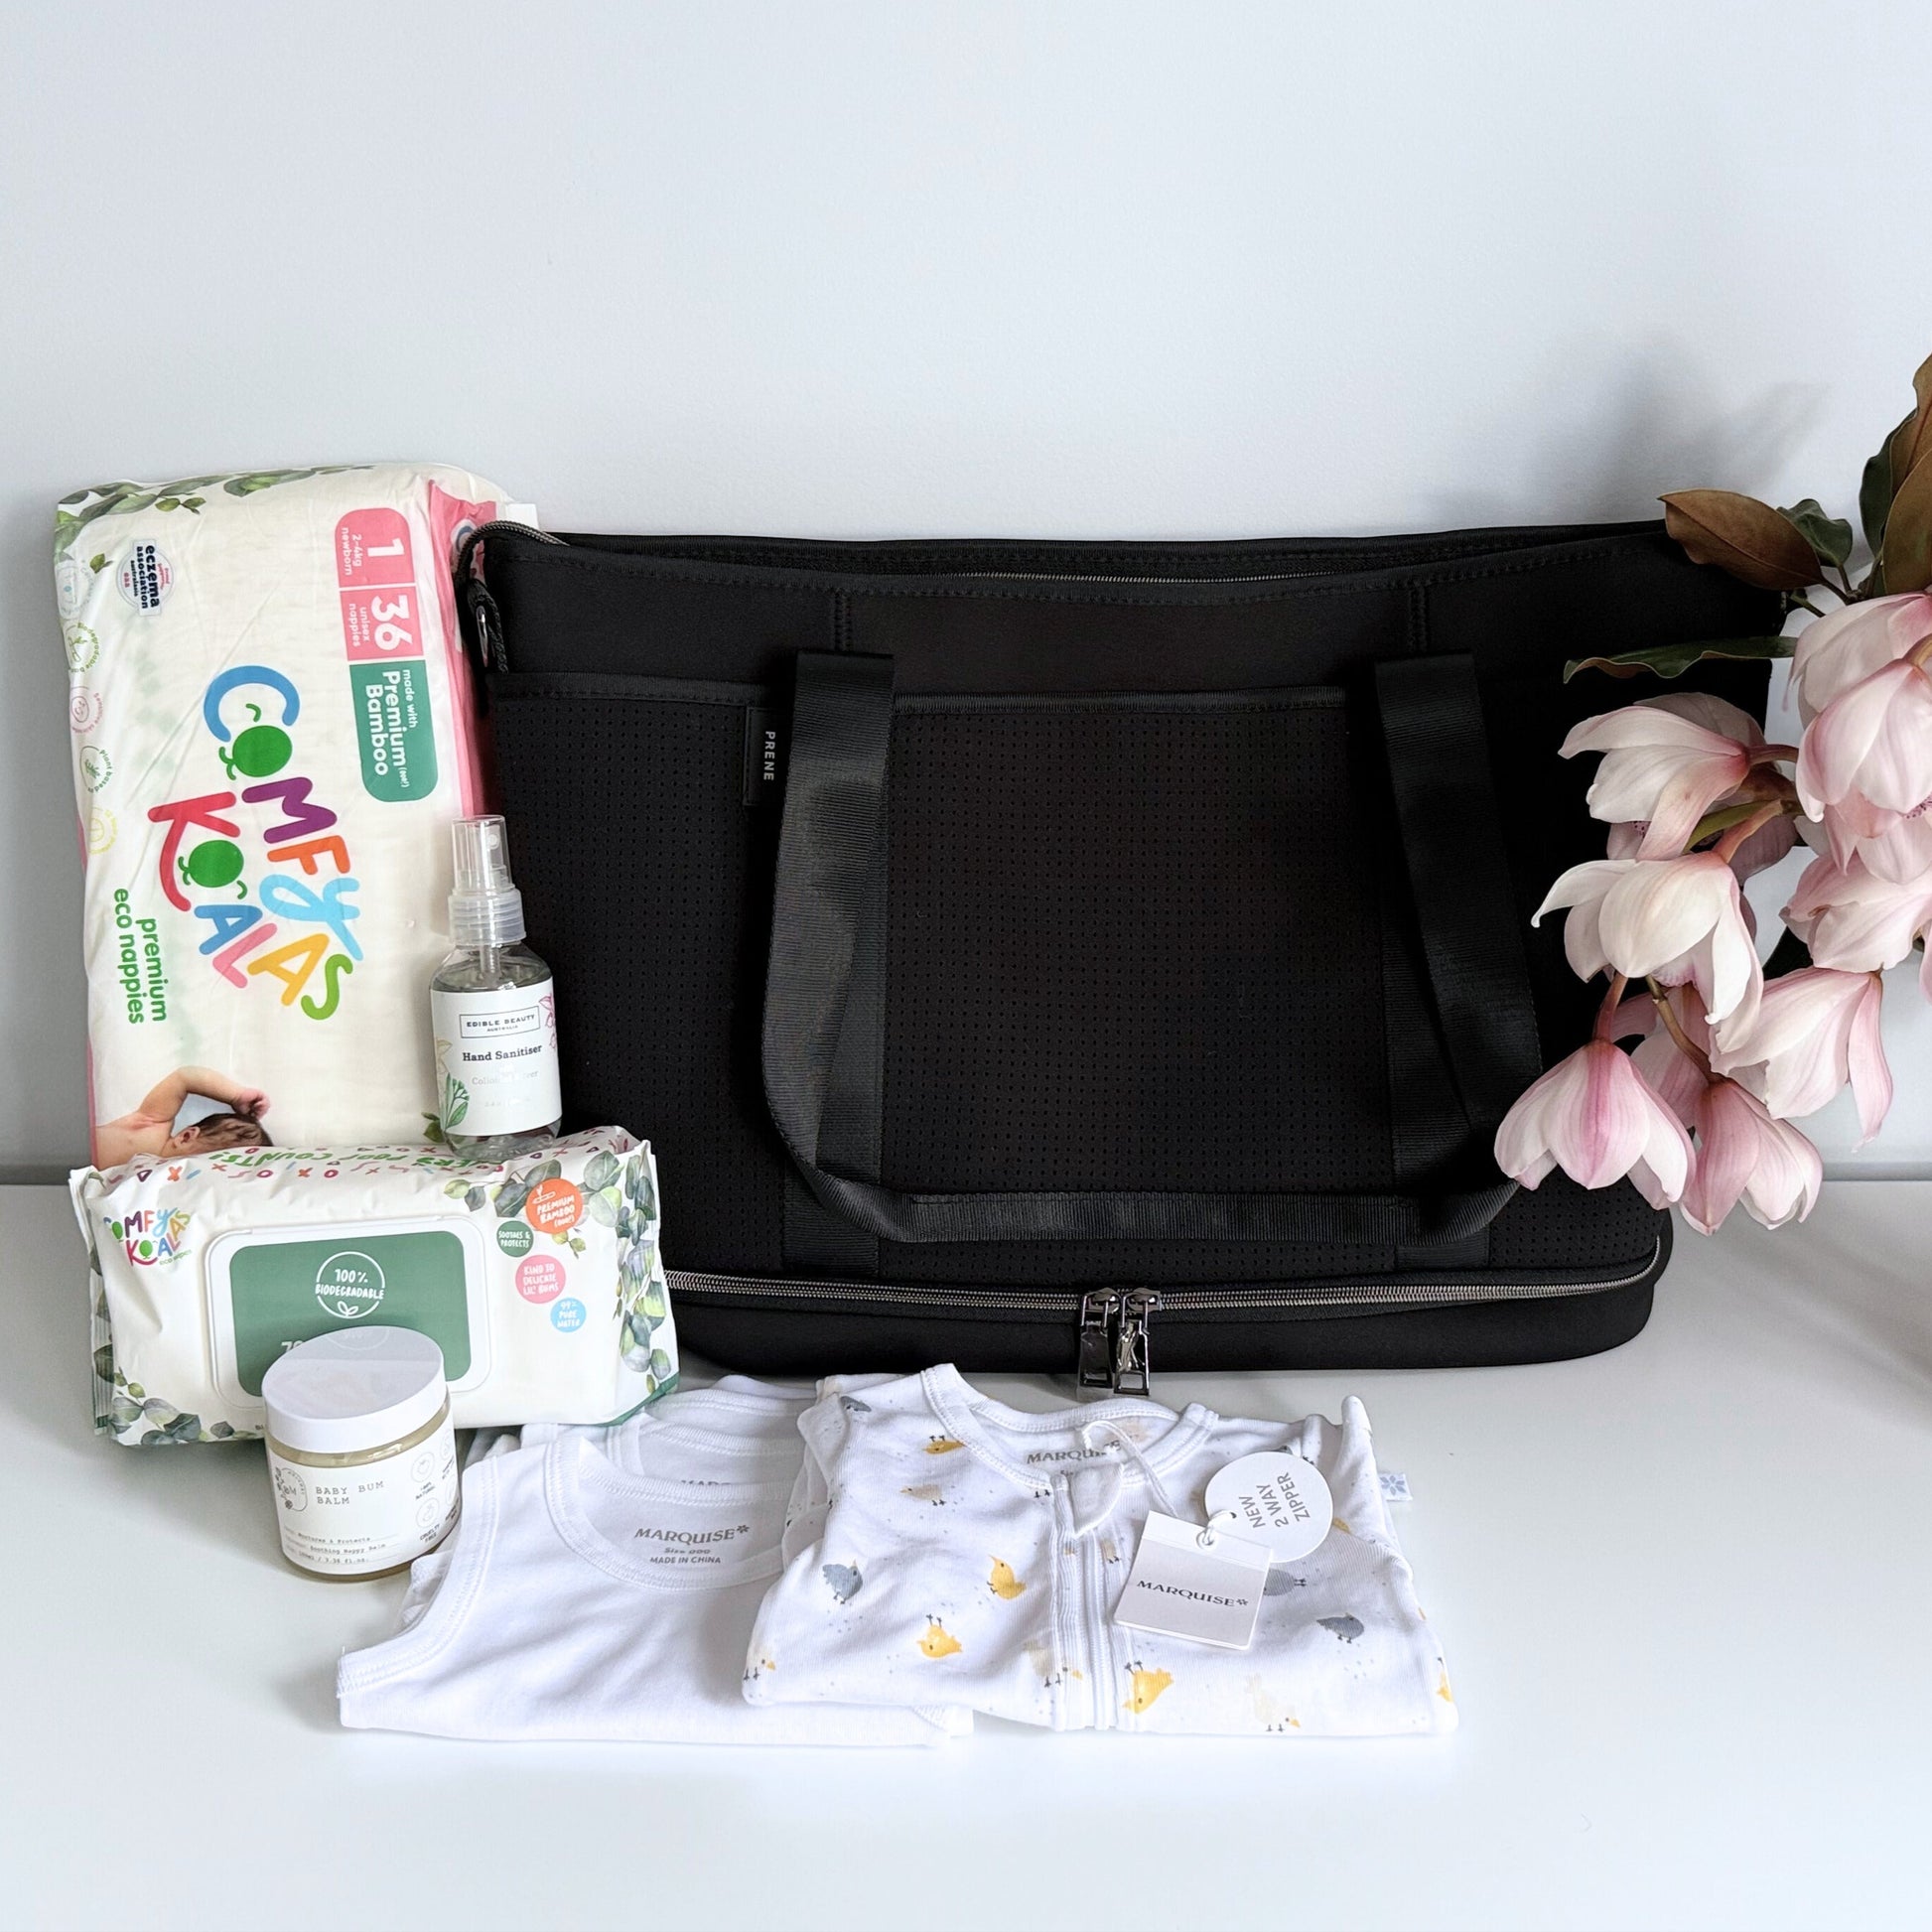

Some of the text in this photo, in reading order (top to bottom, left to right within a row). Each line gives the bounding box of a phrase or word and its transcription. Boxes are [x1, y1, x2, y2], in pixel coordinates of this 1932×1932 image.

[341, 527, 352, 576] newborn
[351, 534, 363, 567] 2-4kg
[367, 538, 405, 557] 1
[136, 546, 149, 609] association
[145, 545, 161, 608] eczema
[348, 604, 360, 647] nappies
[359, 607, 370, 642] unisex
[370, 595, 413, 651] 36
[381, 670, 408, 766] Premium
[402, 669, 419, 728] made with
[365, 684, 389, 775] Bamboo
[763, 731, 776, 780] PRENE
[204, 665, 363, 961] COMFY
[148, 791, 353, 1021] KOALAS
[114, 889, 147, 1024] eco nappies
[135, 918, 169, 1022] premium
[504, 1014, 536, 1025] BEAUTY
[463, 1044, 543, 1062] Hand Sanitiser
[208, 1151, 334, 1167] COUNTS!
[537, 1195, 575, 1215] PREMIUM
[540, 1205, 575, 1224] BAMBOO
[126, 1210, 191, 1266] KOALAS
[500, 1239, 530, 1249] PROTECTS
[335, 1269, 368, 1283] 100%
[523, 1264, 555, 1276] KIND TO
[315, 1284, 385, 1300] BIODEGRADABLE
[316, 1480, 384, 1495] BABY BUM
[1256, 1483, 1289, 1528] 2 WAY
[1277, 1471, 1311, 1523] ZIPPER
[1238, 1495, 1266, 1529] NEW
[649, 1556, 721, 1565] MADE IN CHINA
